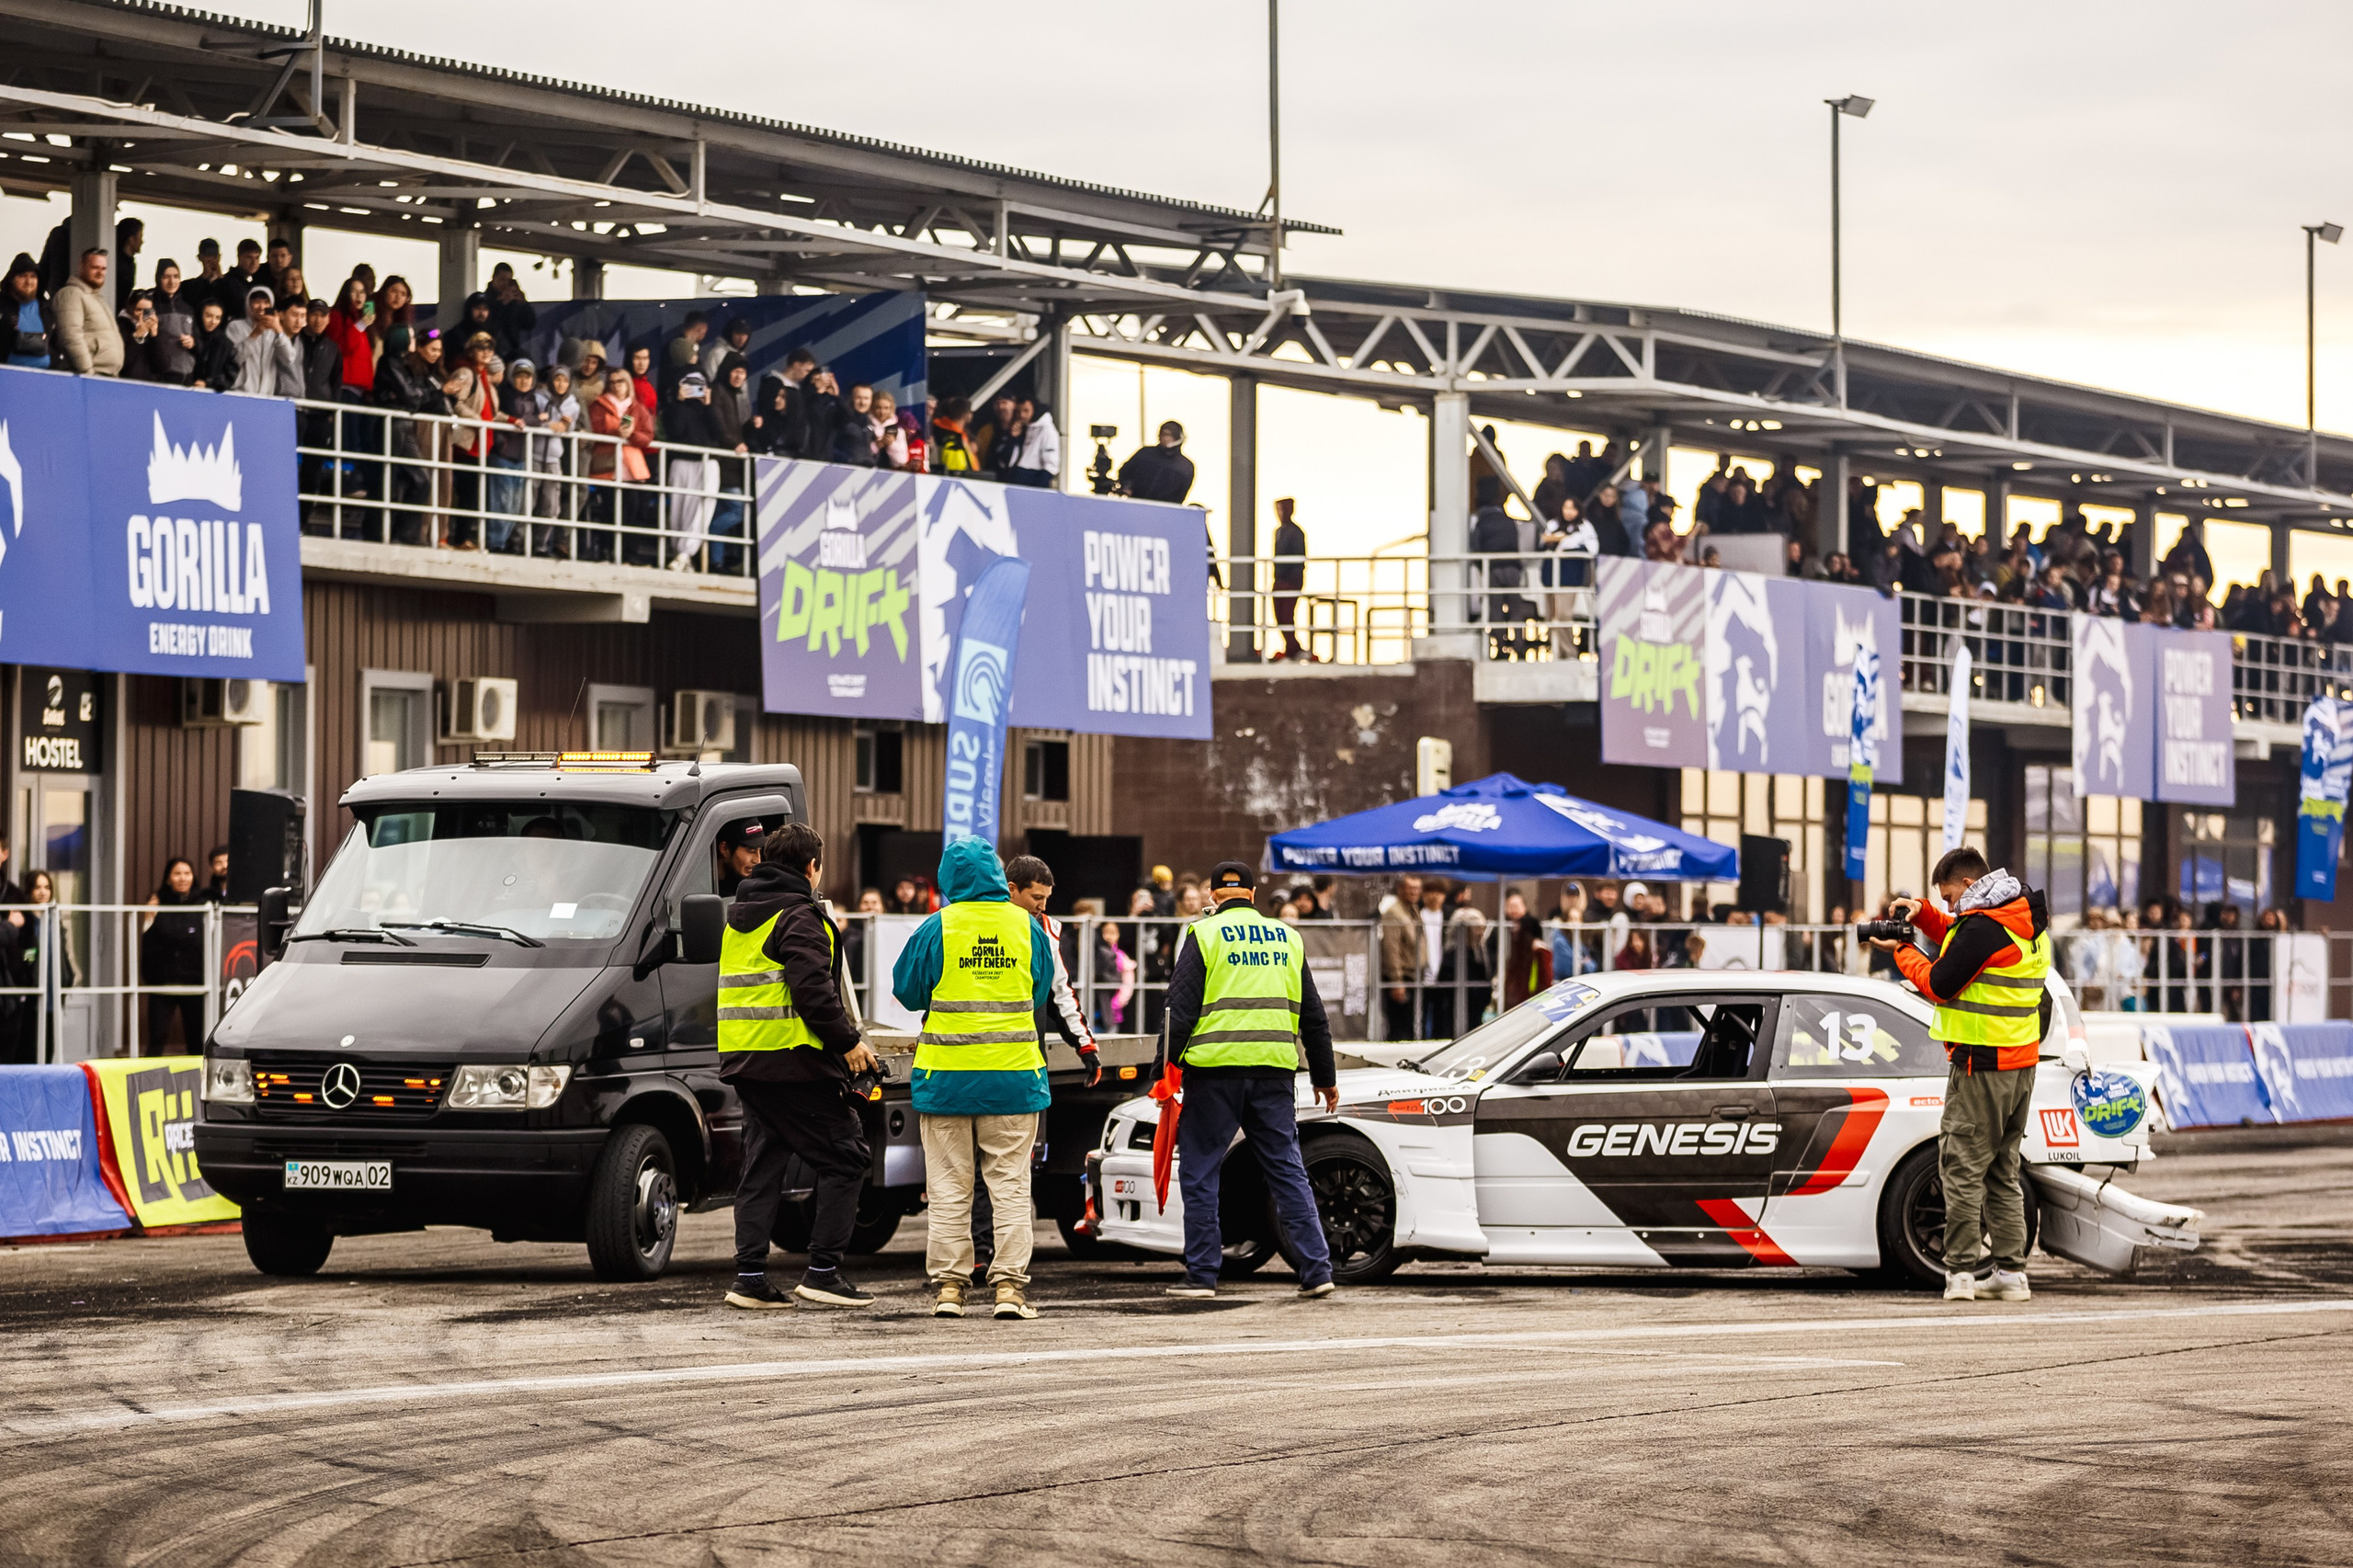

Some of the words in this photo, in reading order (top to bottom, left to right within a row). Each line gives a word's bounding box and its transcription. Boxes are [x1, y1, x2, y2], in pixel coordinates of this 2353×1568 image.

[127, 515, 270, 615] GORILLA
[1084, 529, 1170, 595] POWER
[777, 560, 909, 664] DRIFT
[1086, 591, 1152, 653] YOUR
[149, 622, 207, 656] ENERGY
[208, 625, 254, 659] DRINK
[1086, 653, 1197, 716] INSTINCT
[25, 736, 84, 769] HOSTEL
[1388, 844, 1460, 866] INSTINCT
[972, 945, 1005, 957] GORILLA
[1221, 925, 1288, 944] СУДЬЯ
[959, 957, 983, 969] DRIFT
[983, 957, 1017, 970] ENERGY
[1227, 952, 1269, 966] ФАМС
[1818, 1011, 1878, 1061] 13
[2084, 1096, 2142, 1122] DRIFT
[11, 1130, 82, 1163] INSTINCT
[1567, 1122, 1782, 1157] GENESIS
[2048, 1152, 2081, 1161] LUKOIL
[368, 1165, 390, 1186] 02
